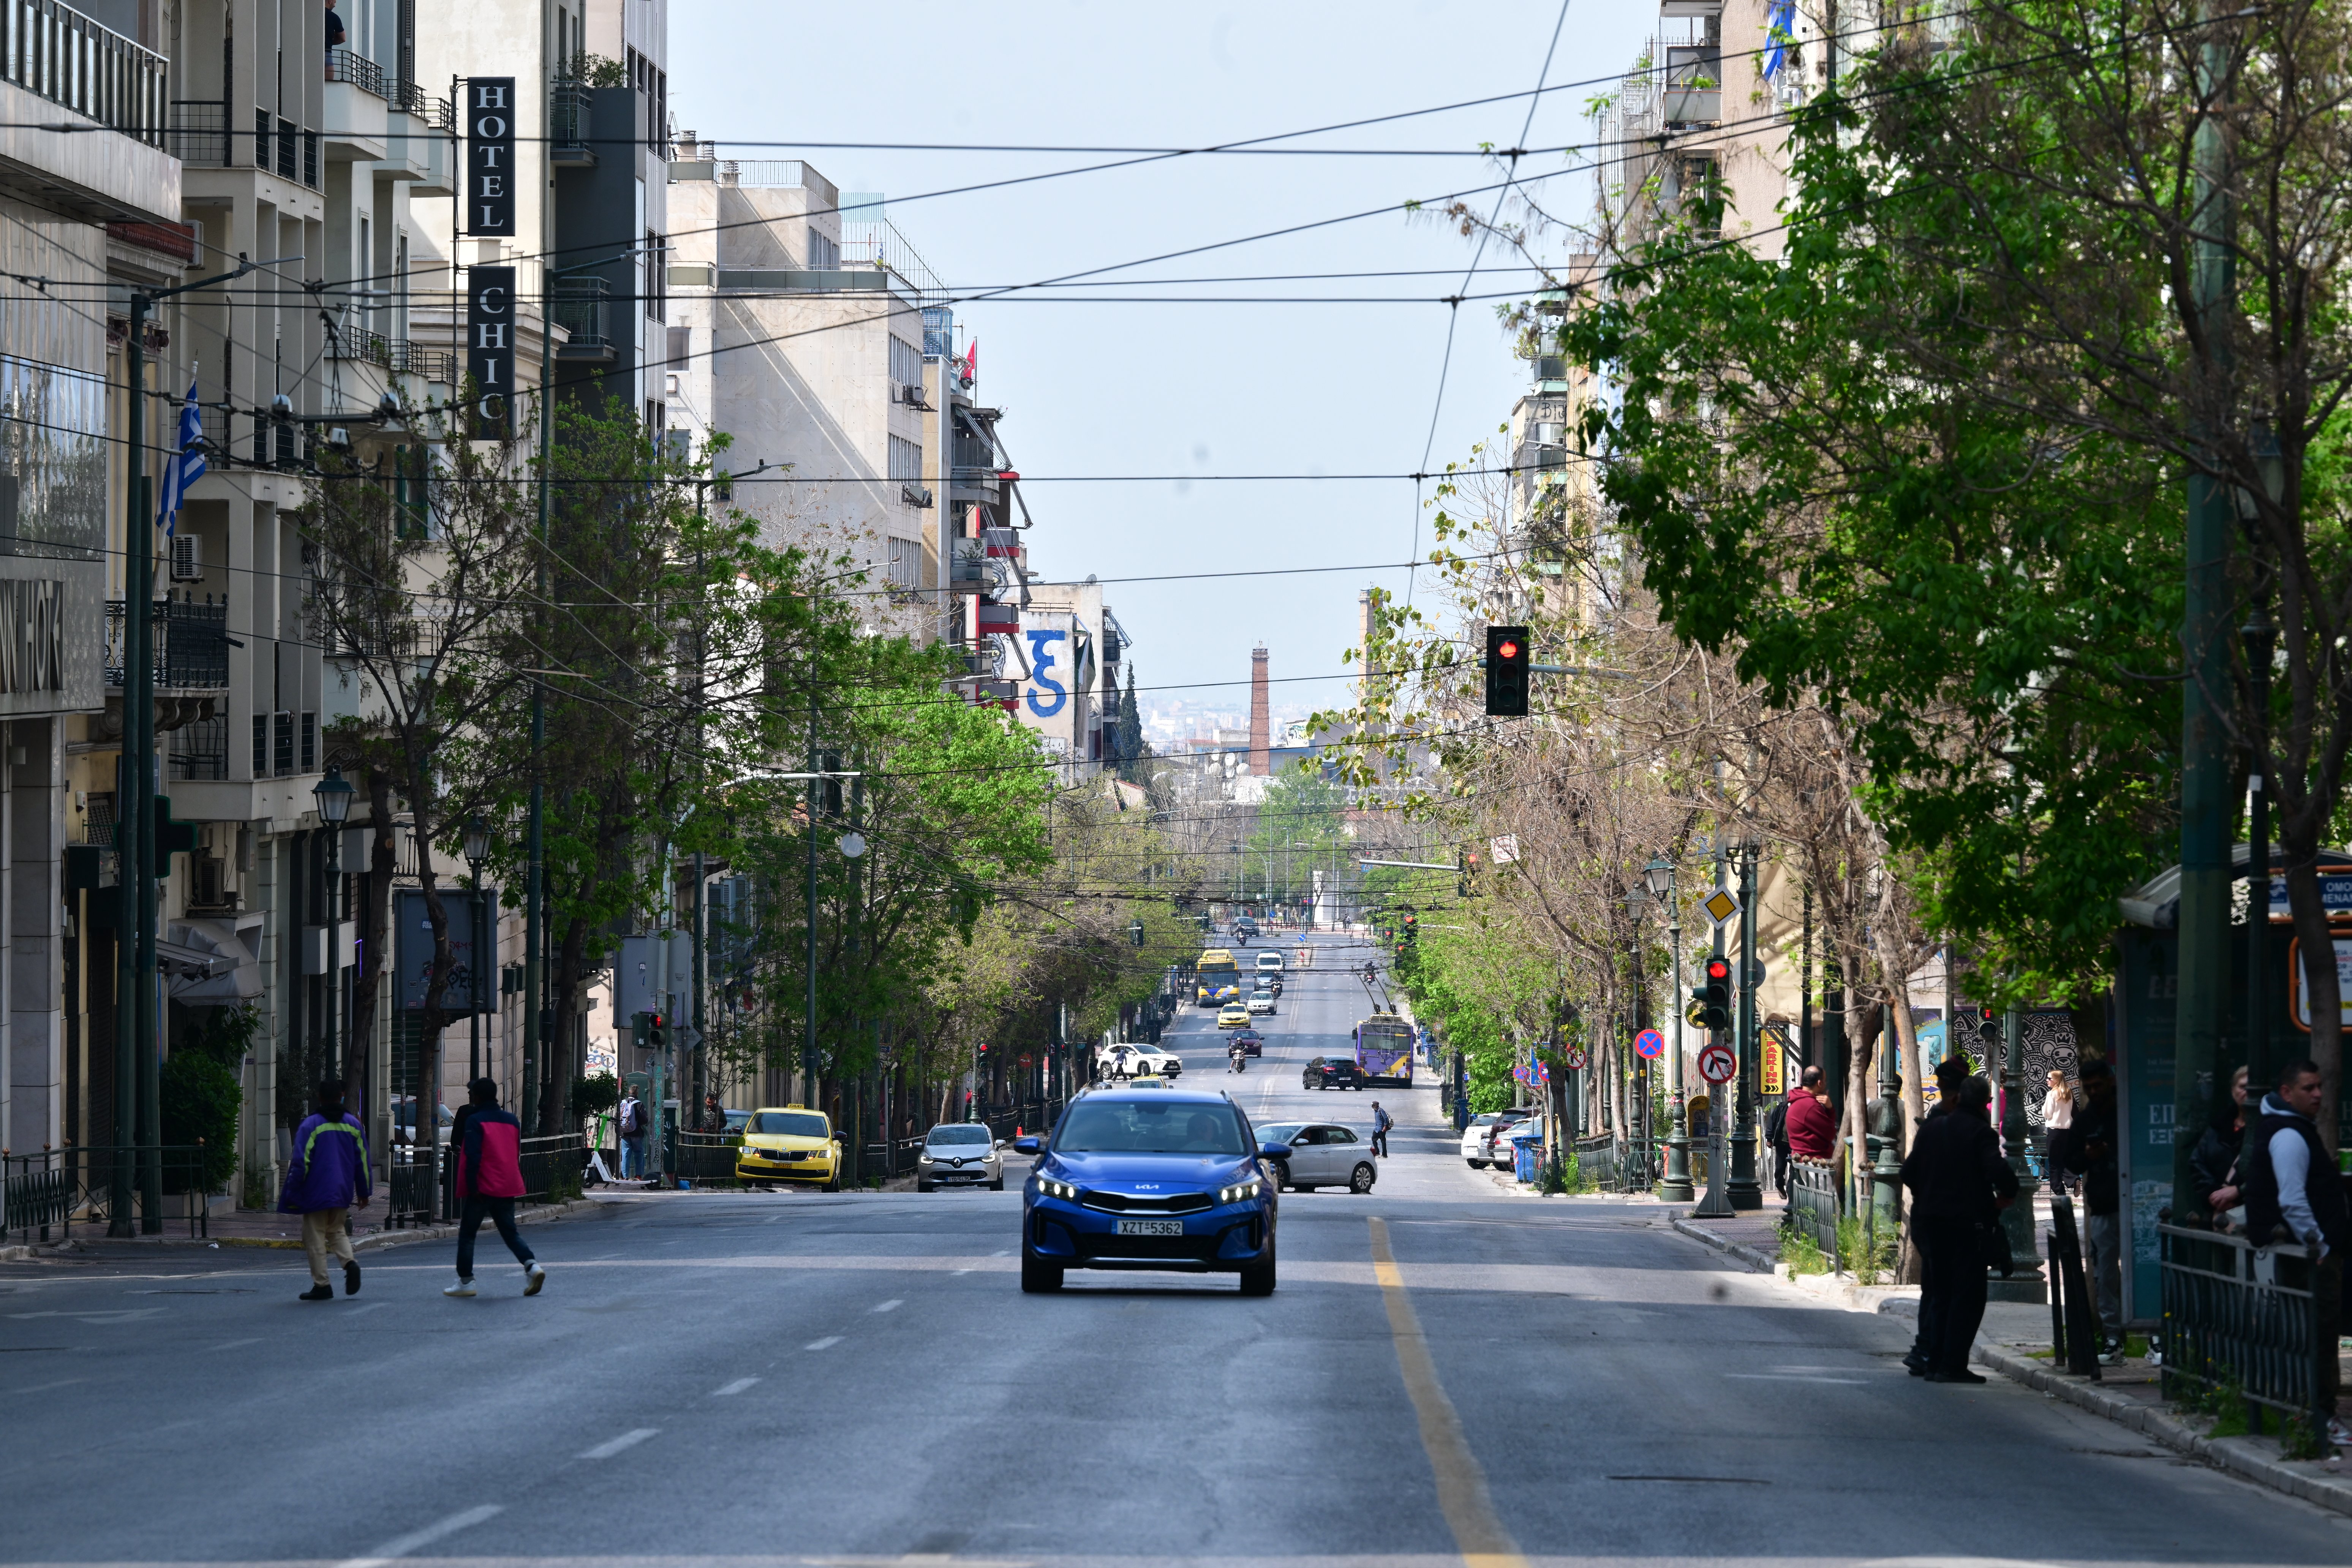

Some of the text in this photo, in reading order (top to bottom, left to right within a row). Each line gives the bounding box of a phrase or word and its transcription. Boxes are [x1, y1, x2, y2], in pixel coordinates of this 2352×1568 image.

[476, 86, 507, 227] HOTEL
[476, 287, 507, 420] CHIC
[1766, 1041, 1777, 1083] PARKING
[1122, 1222, 1180, 1234] XZT-5362
